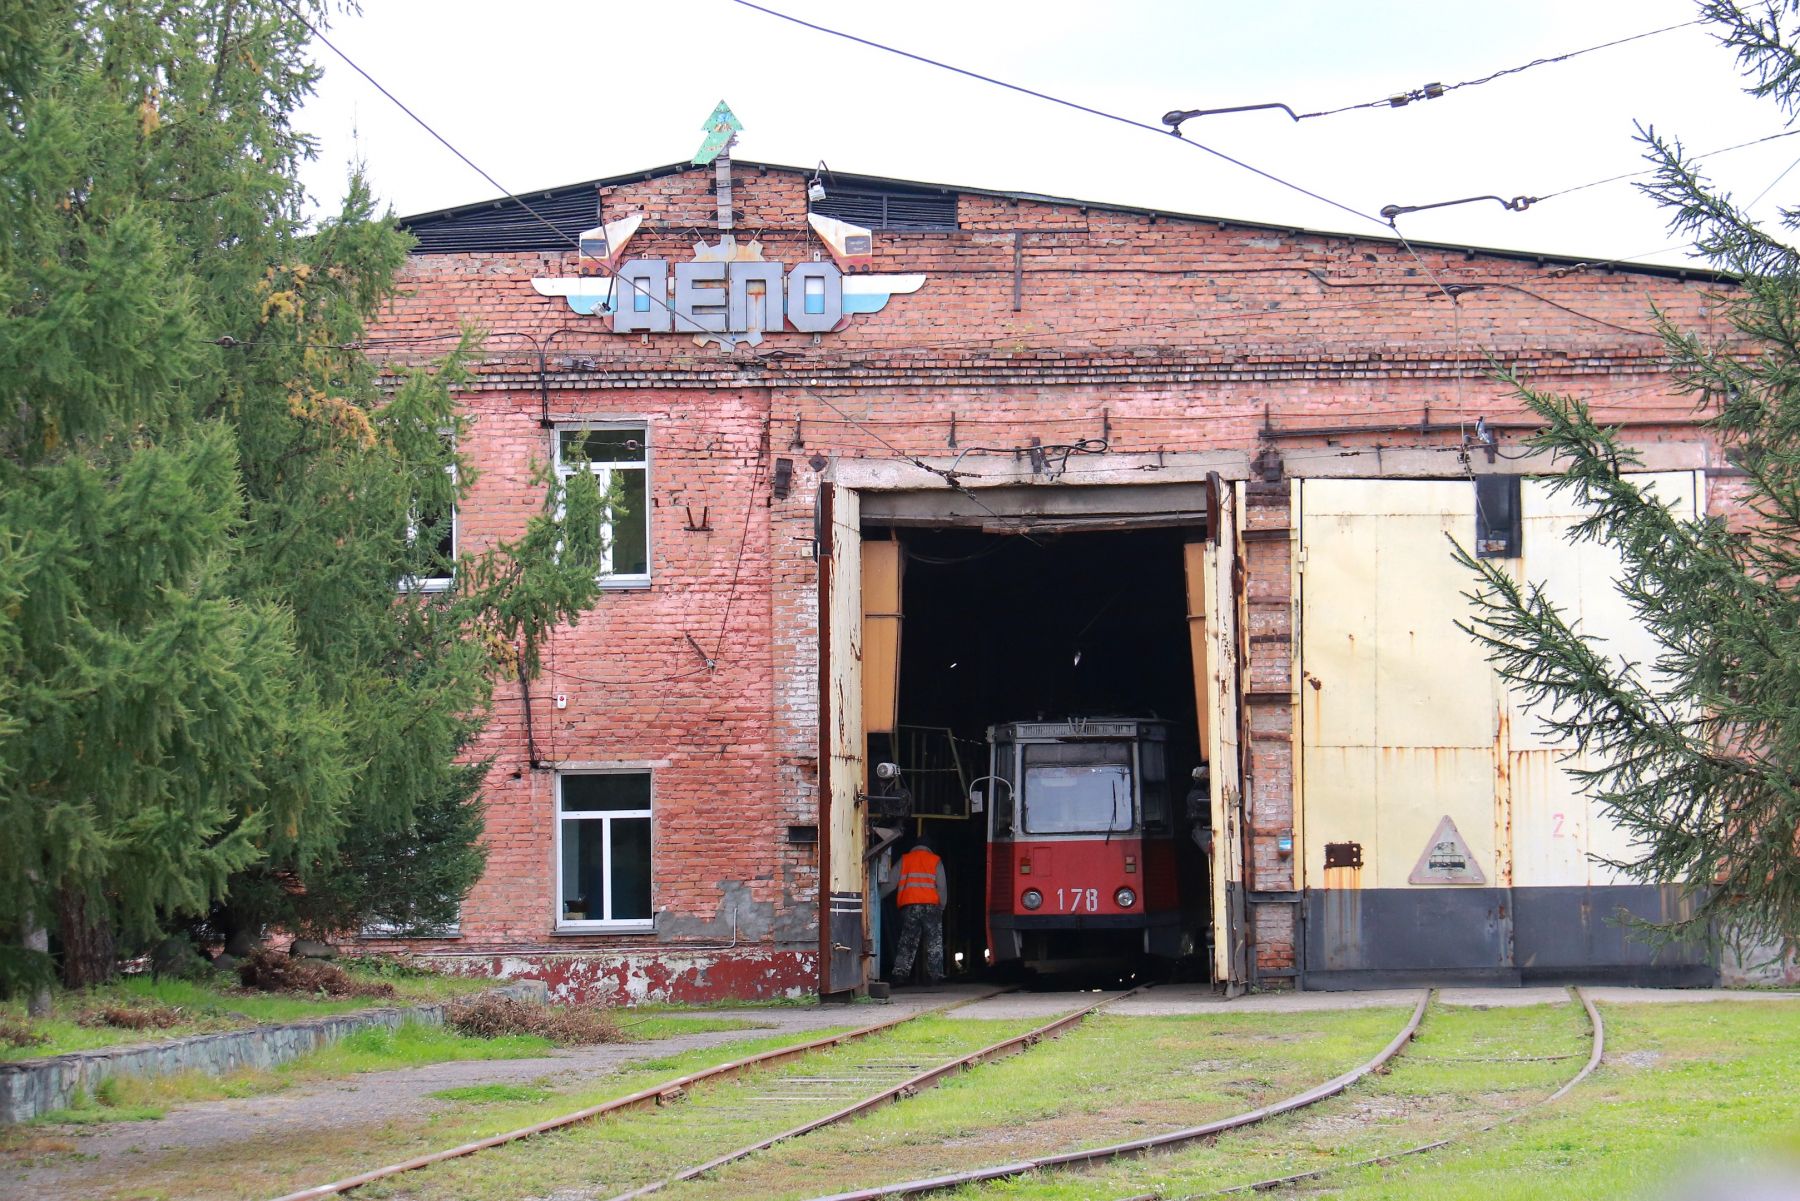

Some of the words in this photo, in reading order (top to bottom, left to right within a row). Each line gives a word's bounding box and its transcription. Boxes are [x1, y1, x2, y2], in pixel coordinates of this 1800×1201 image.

[613, 259, 843, 333] ДЕПО
[1553, 813, 1565, 838] 2
[1057, 888, 1098, 912] 178
